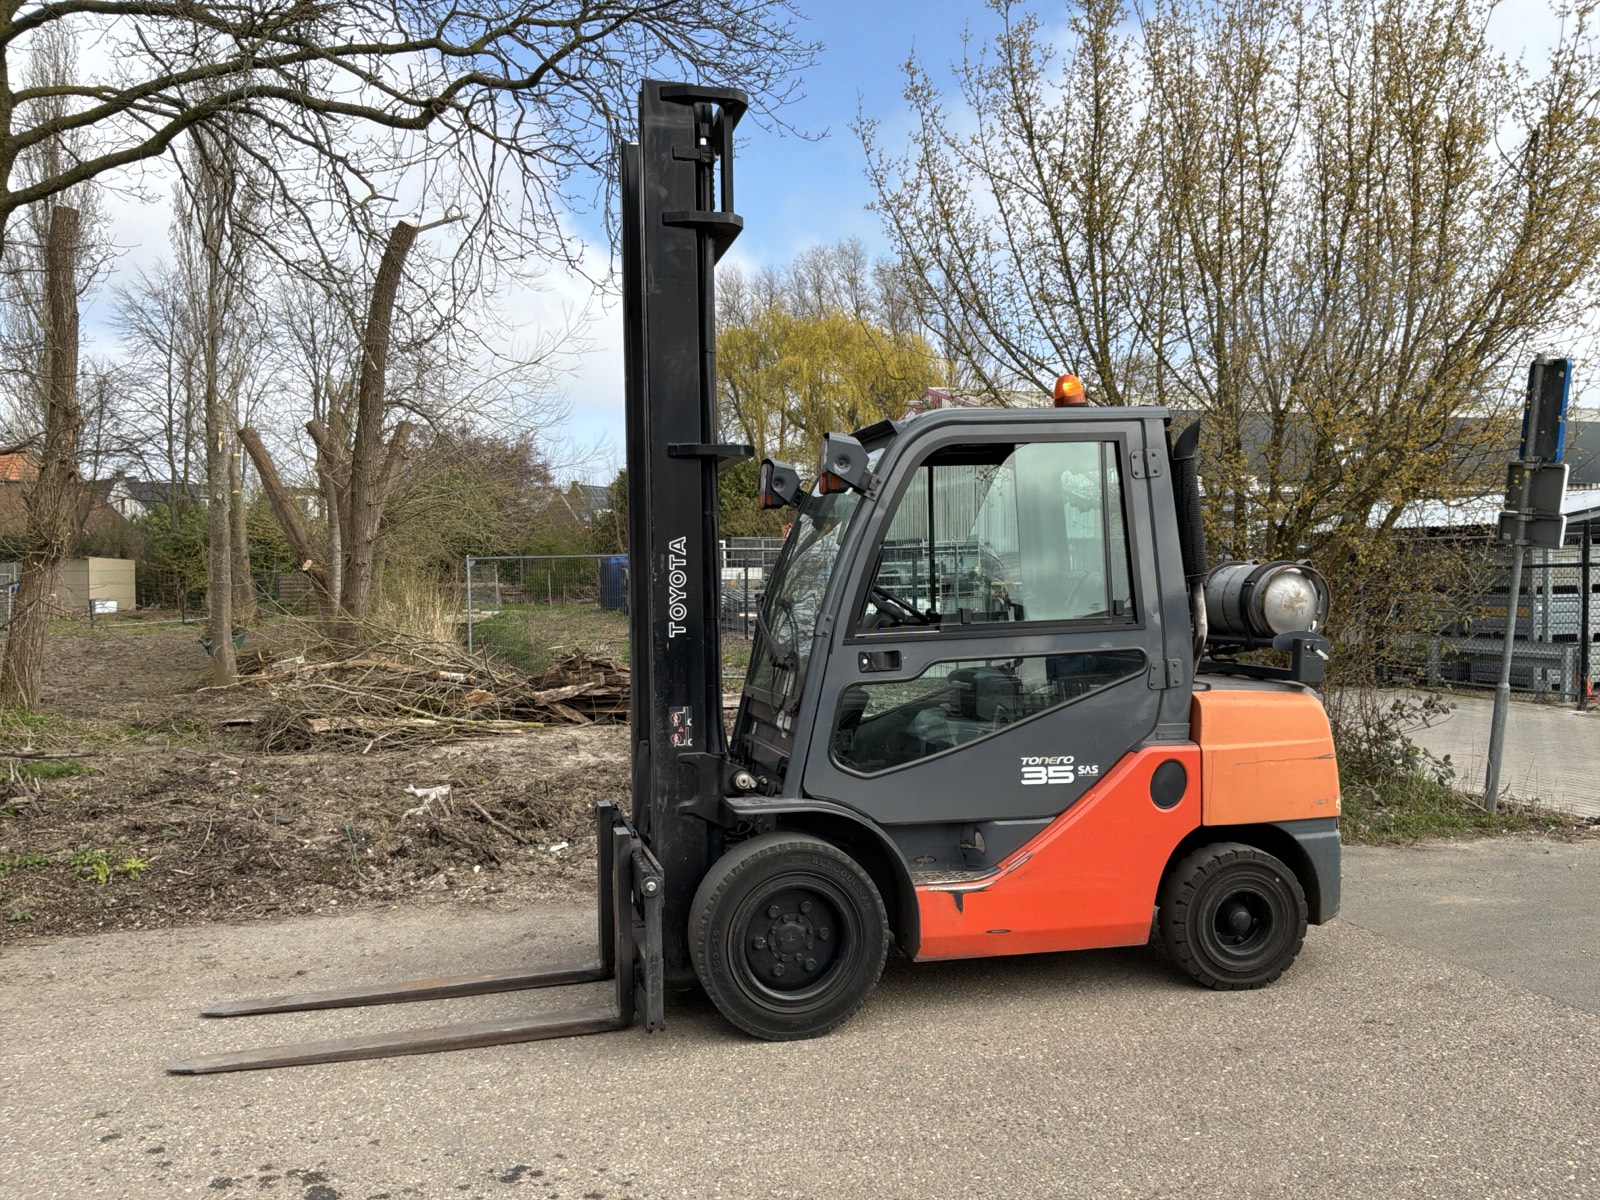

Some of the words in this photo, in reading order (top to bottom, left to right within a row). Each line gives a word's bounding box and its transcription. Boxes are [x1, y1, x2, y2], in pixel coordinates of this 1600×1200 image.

[668, 536, 687, 638] TOYOTA
[1020, 765, 1075, 786] 35
[1077, 764, 1099, 775] SAS
